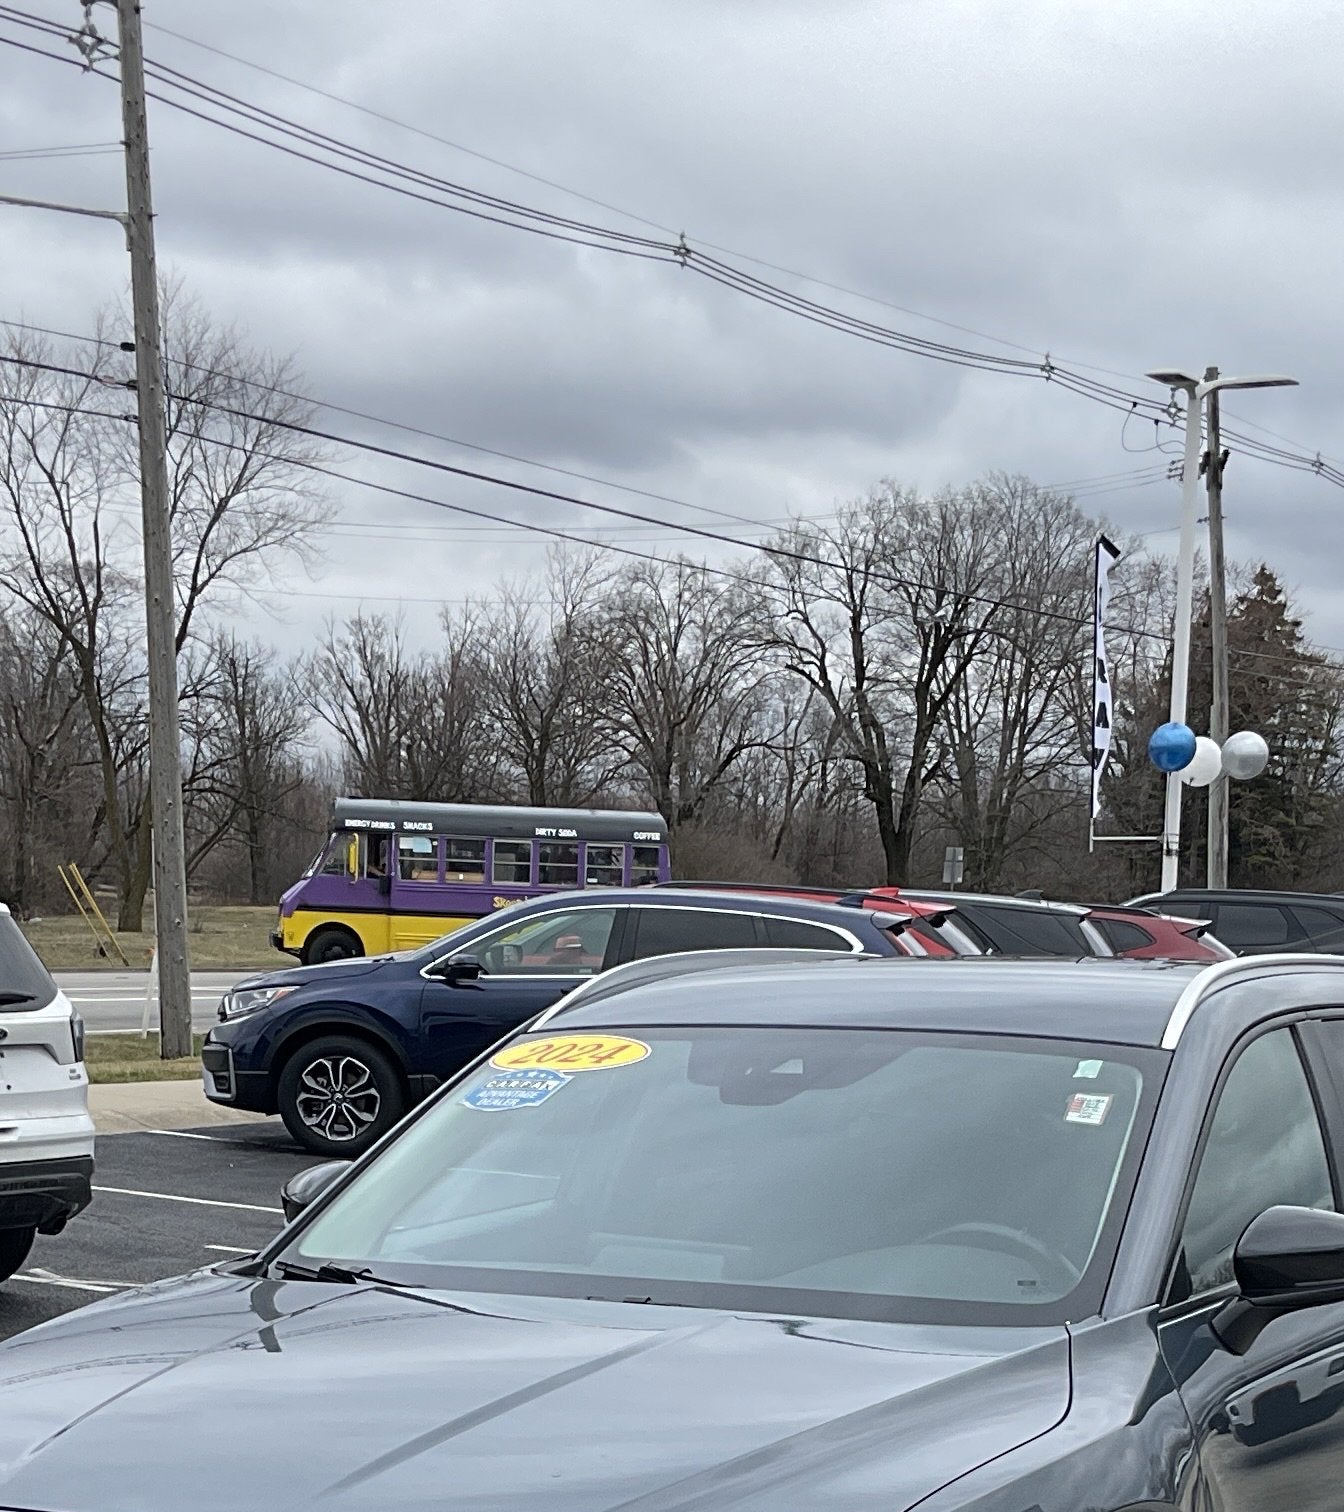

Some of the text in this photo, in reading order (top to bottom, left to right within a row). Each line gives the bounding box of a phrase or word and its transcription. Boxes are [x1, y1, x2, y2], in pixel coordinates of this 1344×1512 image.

[403, 821, 433, 831] SNACKS
[535, 827, 577, 838] DIRTY SODA
[633, 831, 661, 841] COFFEE
[507, 1043, 633, 1064] 2024
[486, 1079, 558, 1091] CARFAX
[476, 1089, 540, 1099] ADVANTAGE
[476, 1098, 521, 1107] DEALER
